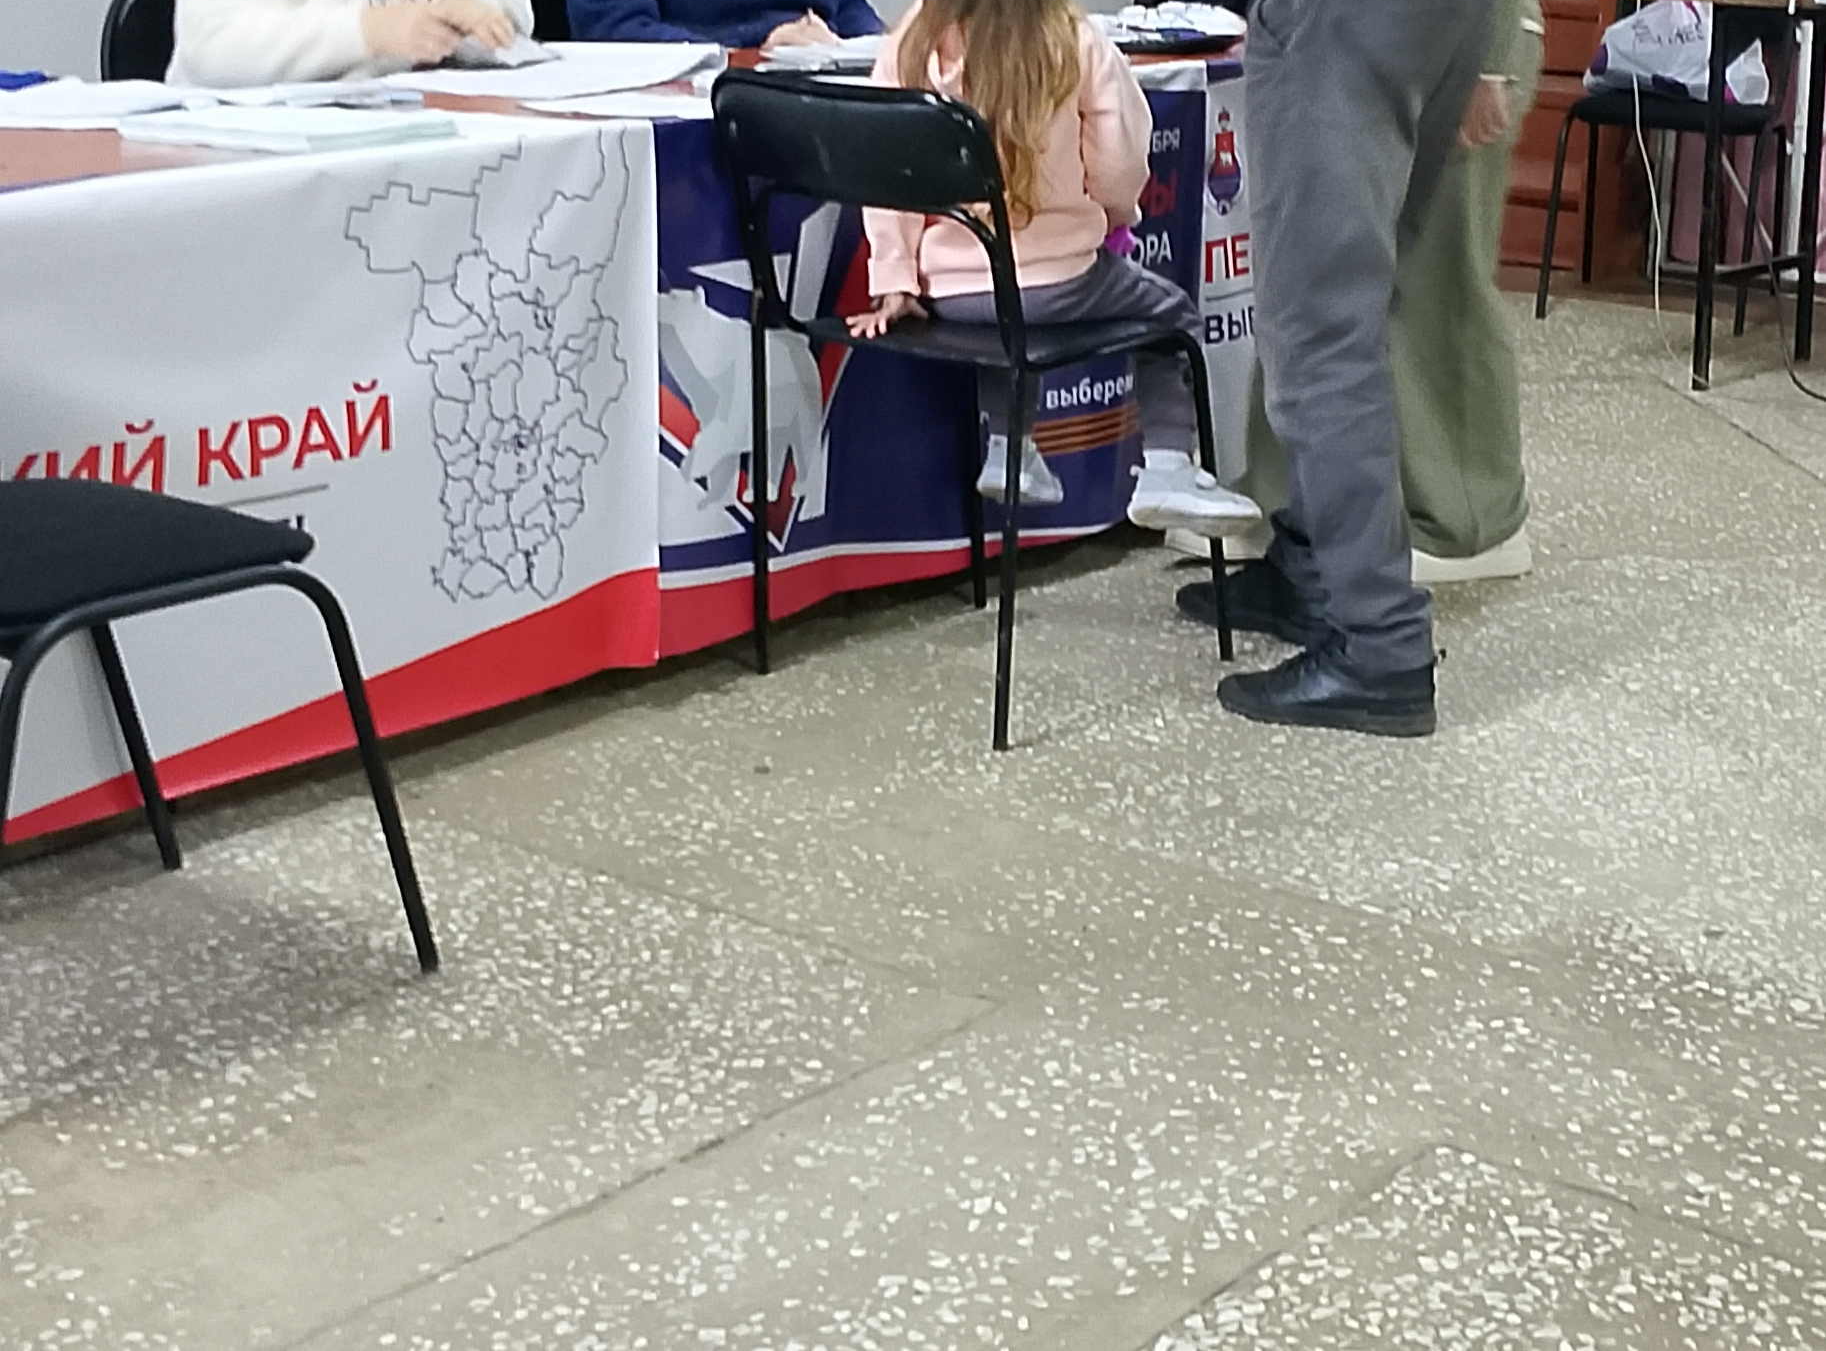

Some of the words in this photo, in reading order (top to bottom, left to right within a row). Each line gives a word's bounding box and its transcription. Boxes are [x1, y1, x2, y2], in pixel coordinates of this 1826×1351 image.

[1152, 127, 1180, 153] БРЯ
[1126, 230, 1173, 267] ОРА
[1205, 233, 1250, 283] ПЕ
[197, 379, 394, 487] КРАЙ
